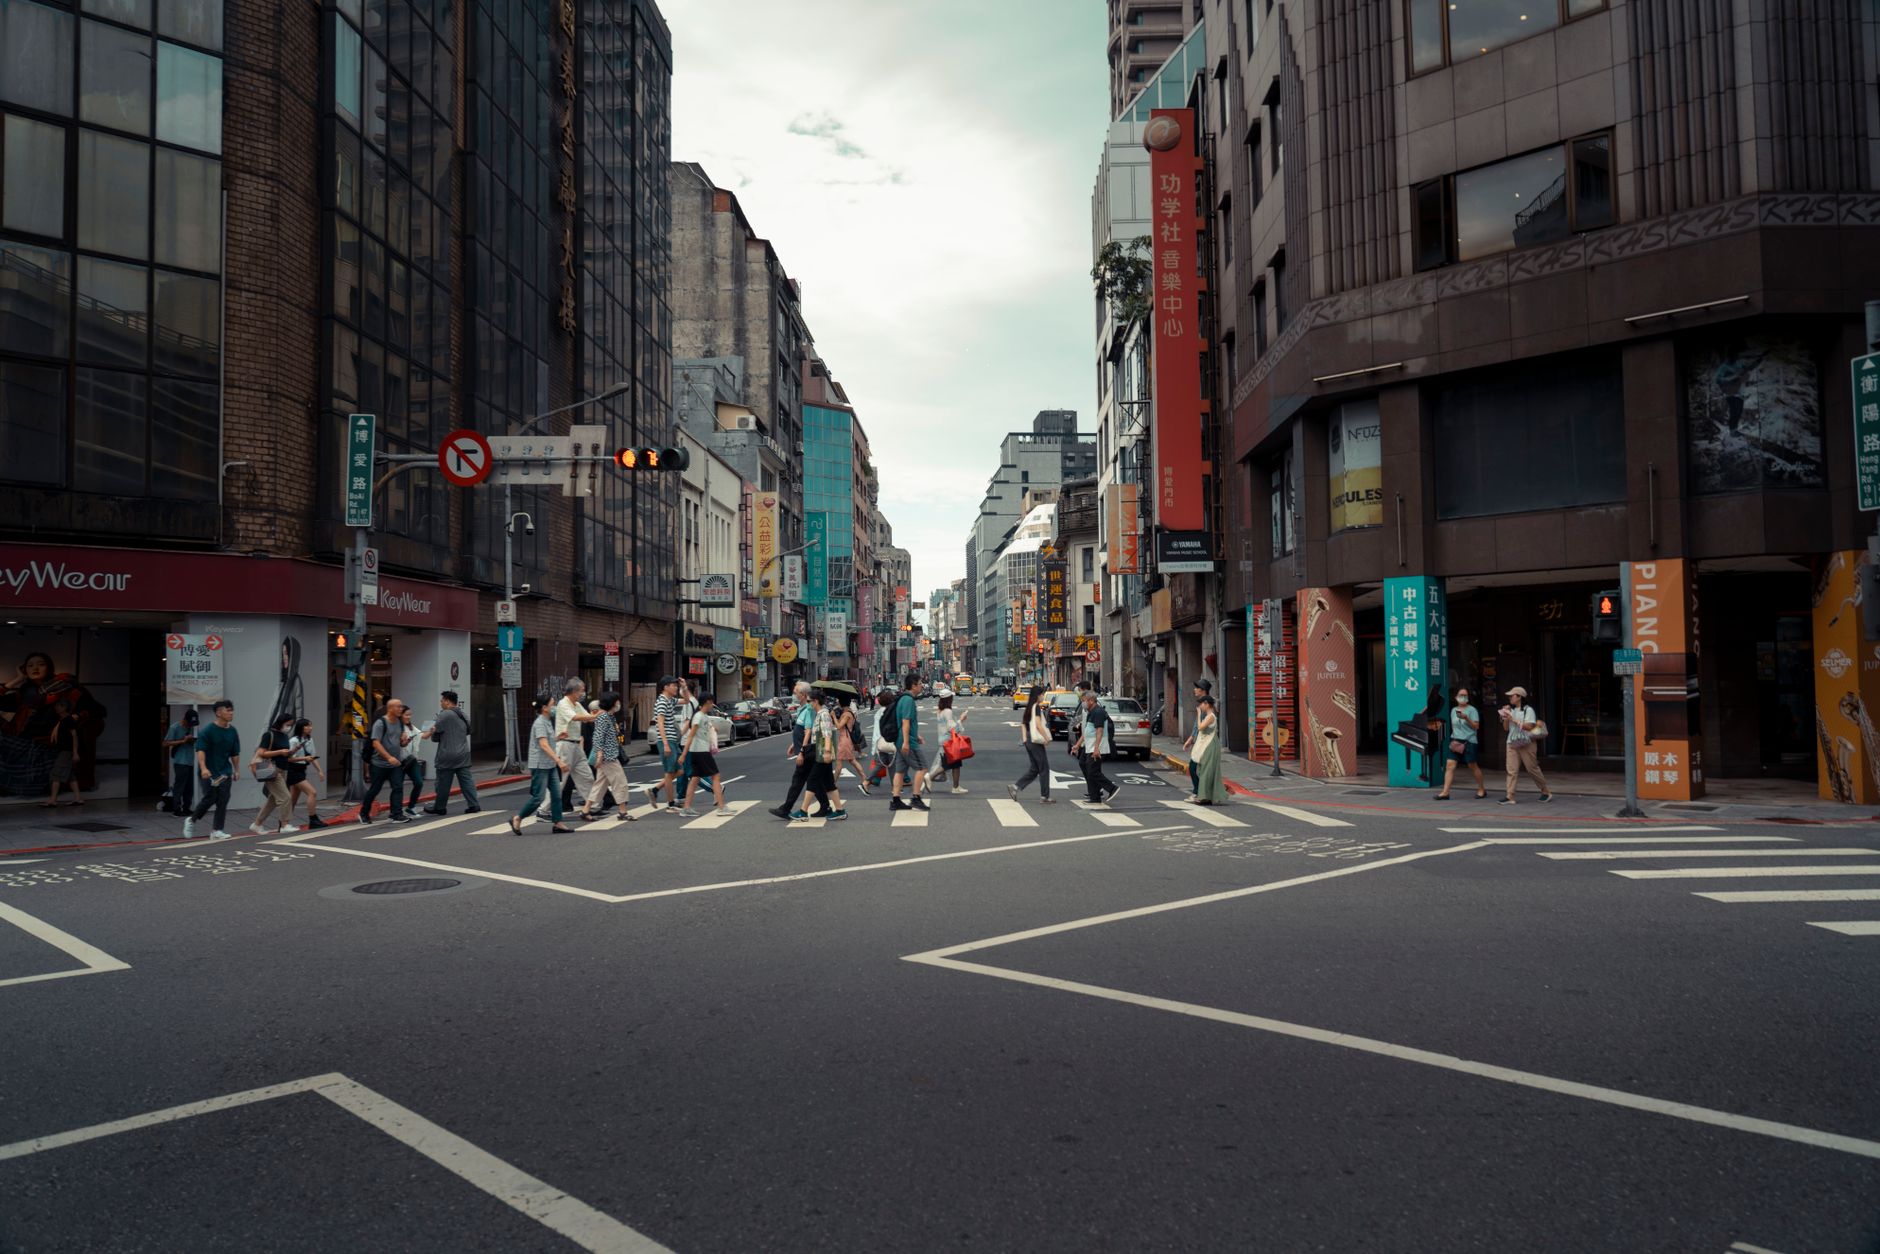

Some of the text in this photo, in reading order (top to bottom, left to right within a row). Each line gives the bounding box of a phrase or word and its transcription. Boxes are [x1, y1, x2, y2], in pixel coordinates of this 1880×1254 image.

[352, 429, 369, 490] 博愛路
[1860, 456, 1879, 464] Heng
[1861, 465, 1878, 474] Yang
[1861, 475, 1874, 483] Rd.
[759, 517, 771, 569] 公益彩券
[380, 586, 432, 616] KeyWear
[1050, 570, 1064, 623] 世運食品
[1402, 587, 1419, 691] 中古鋼琴中心
[1428, 586, 1441, 676] 五大保證
[1821, 658, 1852, 667] SELMER
[1317, 672, 1346, 680] JUPITER
[1644, 751, 1679, 767] 原木
[1644, 769, 1679, 785] 鋼琴
